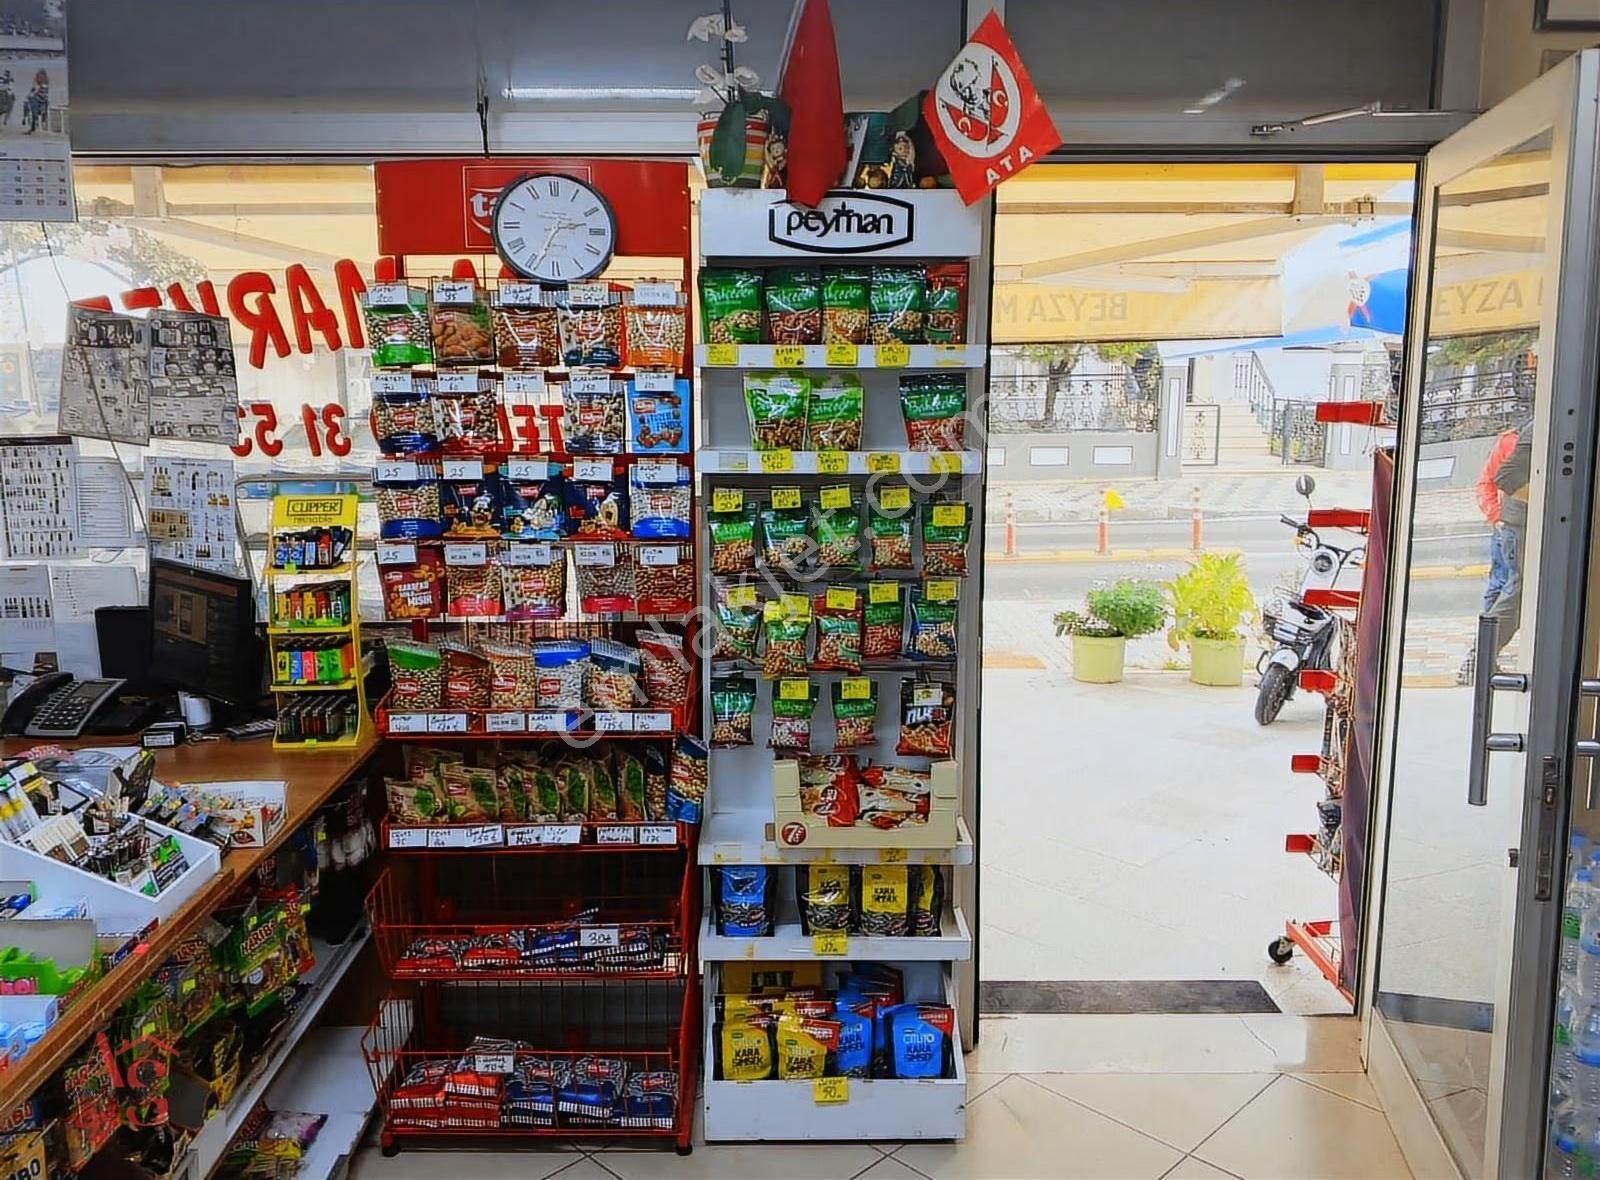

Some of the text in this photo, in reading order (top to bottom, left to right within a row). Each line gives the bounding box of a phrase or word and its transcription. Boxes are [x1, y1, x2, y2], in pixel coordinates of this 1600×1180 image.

[985, 145, 1033, 185] ATA
[787, 201, 893, 238] peyman
[384, 467, 401, 478] 25
[450, 466, 466, 478] 25
[514, 465, 532, 477] 25
[580, 466, 602, 477] 25
[292, 502, 338, 513] CLIPPER
[735, 1048, 761, 1057] KARA
